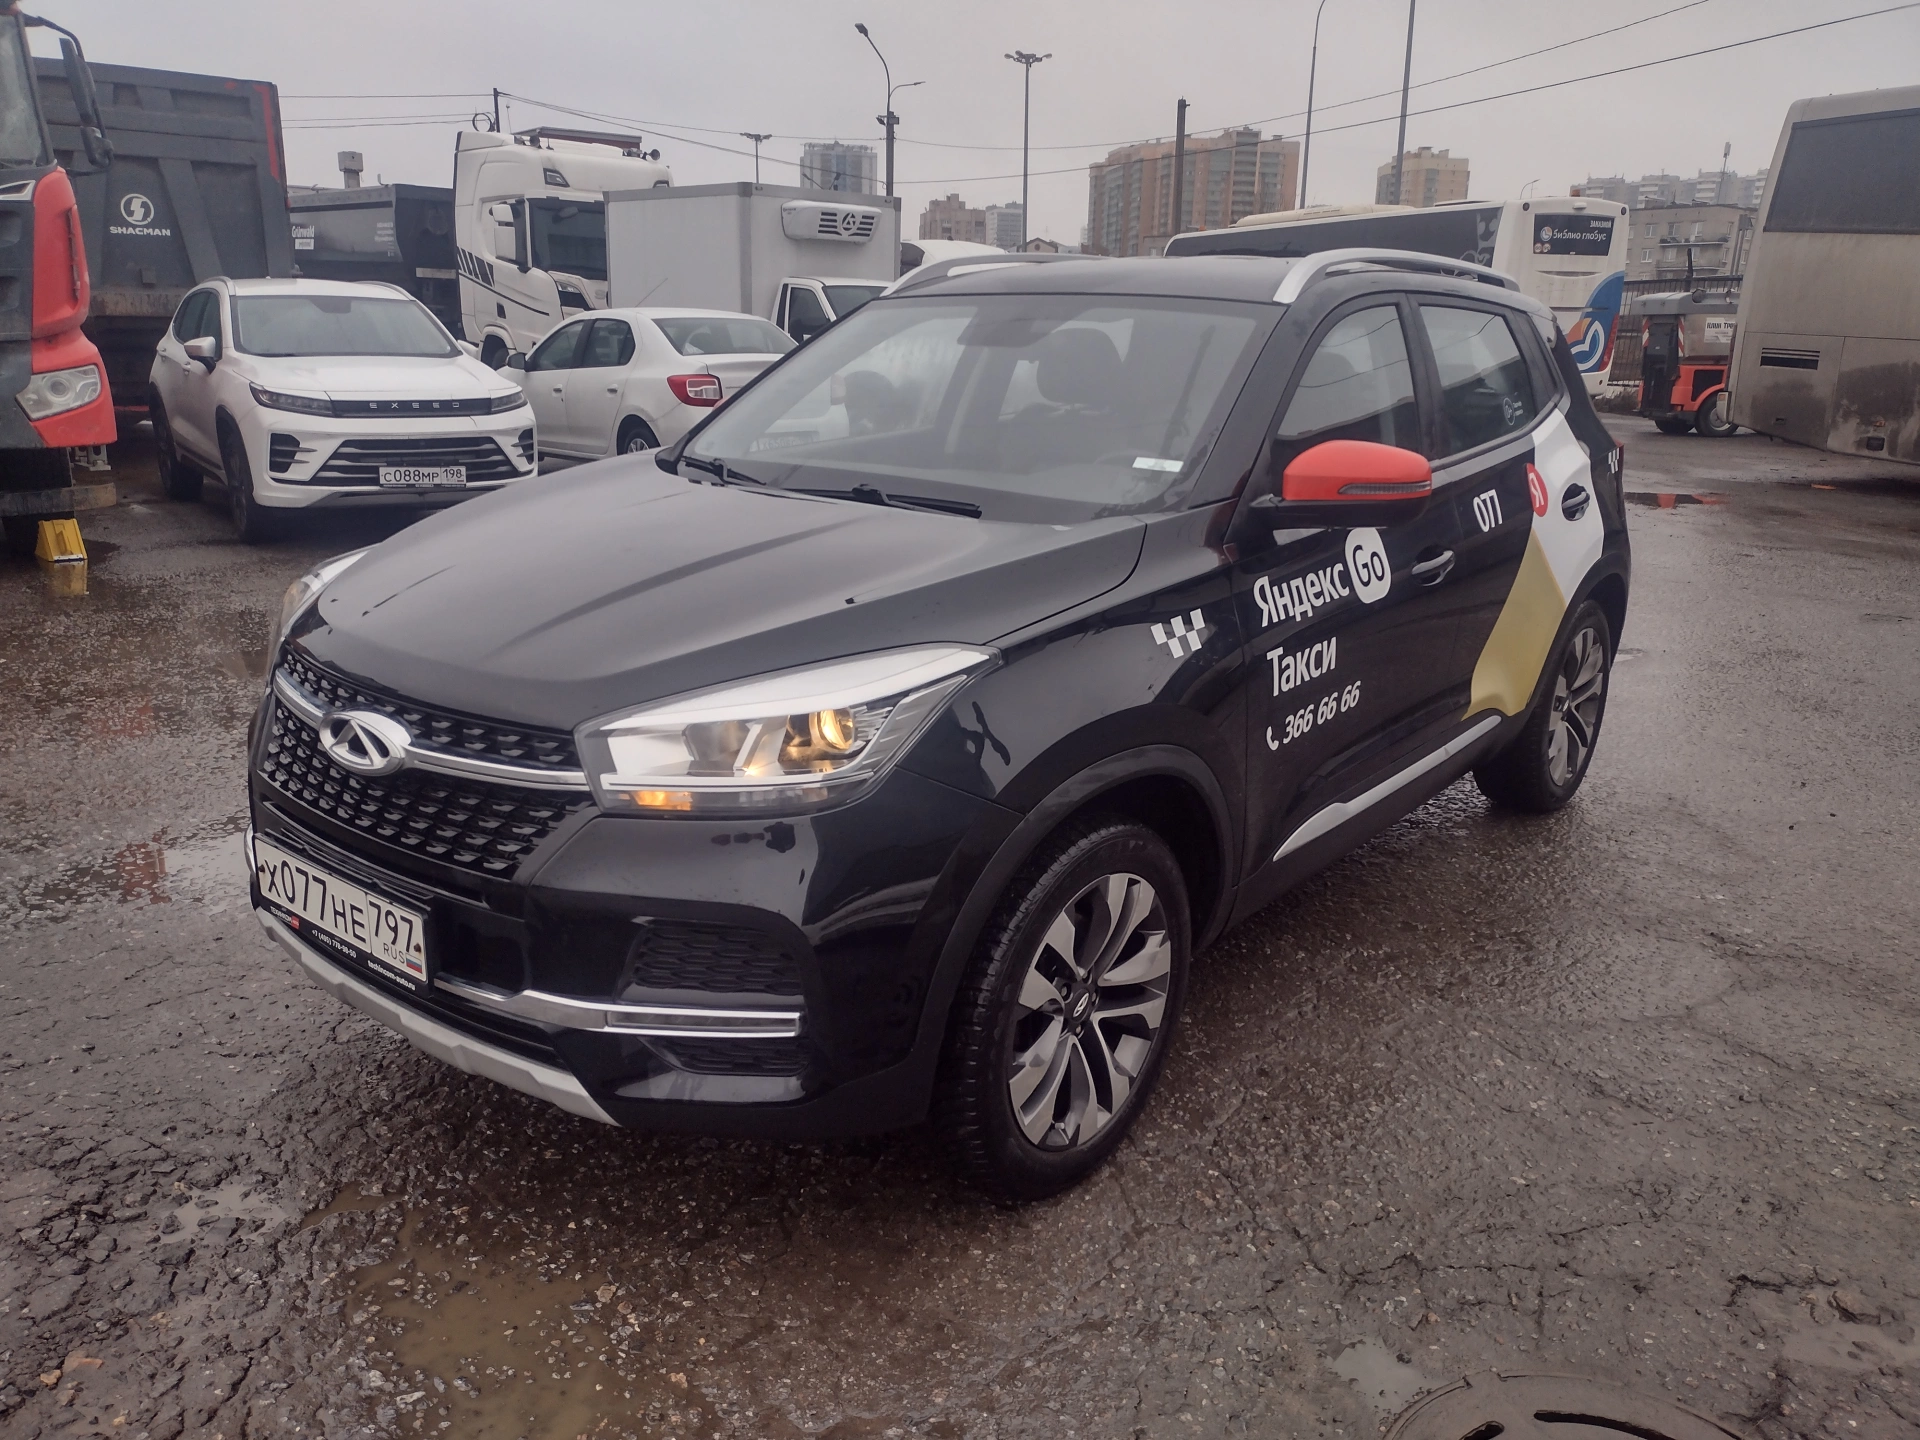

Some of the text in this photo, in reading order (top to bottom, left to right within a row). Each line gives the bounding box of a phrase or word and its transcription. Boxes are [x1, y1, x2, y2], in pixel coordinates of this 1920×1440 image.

[109, 226, 171, 237] SHACMAN
[291, 225, 315, 238] Grünwald
[1553, 229, 1607, 242] библио глобус
[369, 401, 460, 409] EXEED
[442, 468, 462, 479] 198
[1529, 472, 1545, 508] Я
[1472, 488, 1503, 533] 077
[1253, 544, 1386, 628] Яндекс Go
[1266, 636, 1337, 697] Такси
[1283, 680, 1361, 744] 366 66 66
[369, 899, 414, 953] 797
[383, 944, 405, 964] RUS
